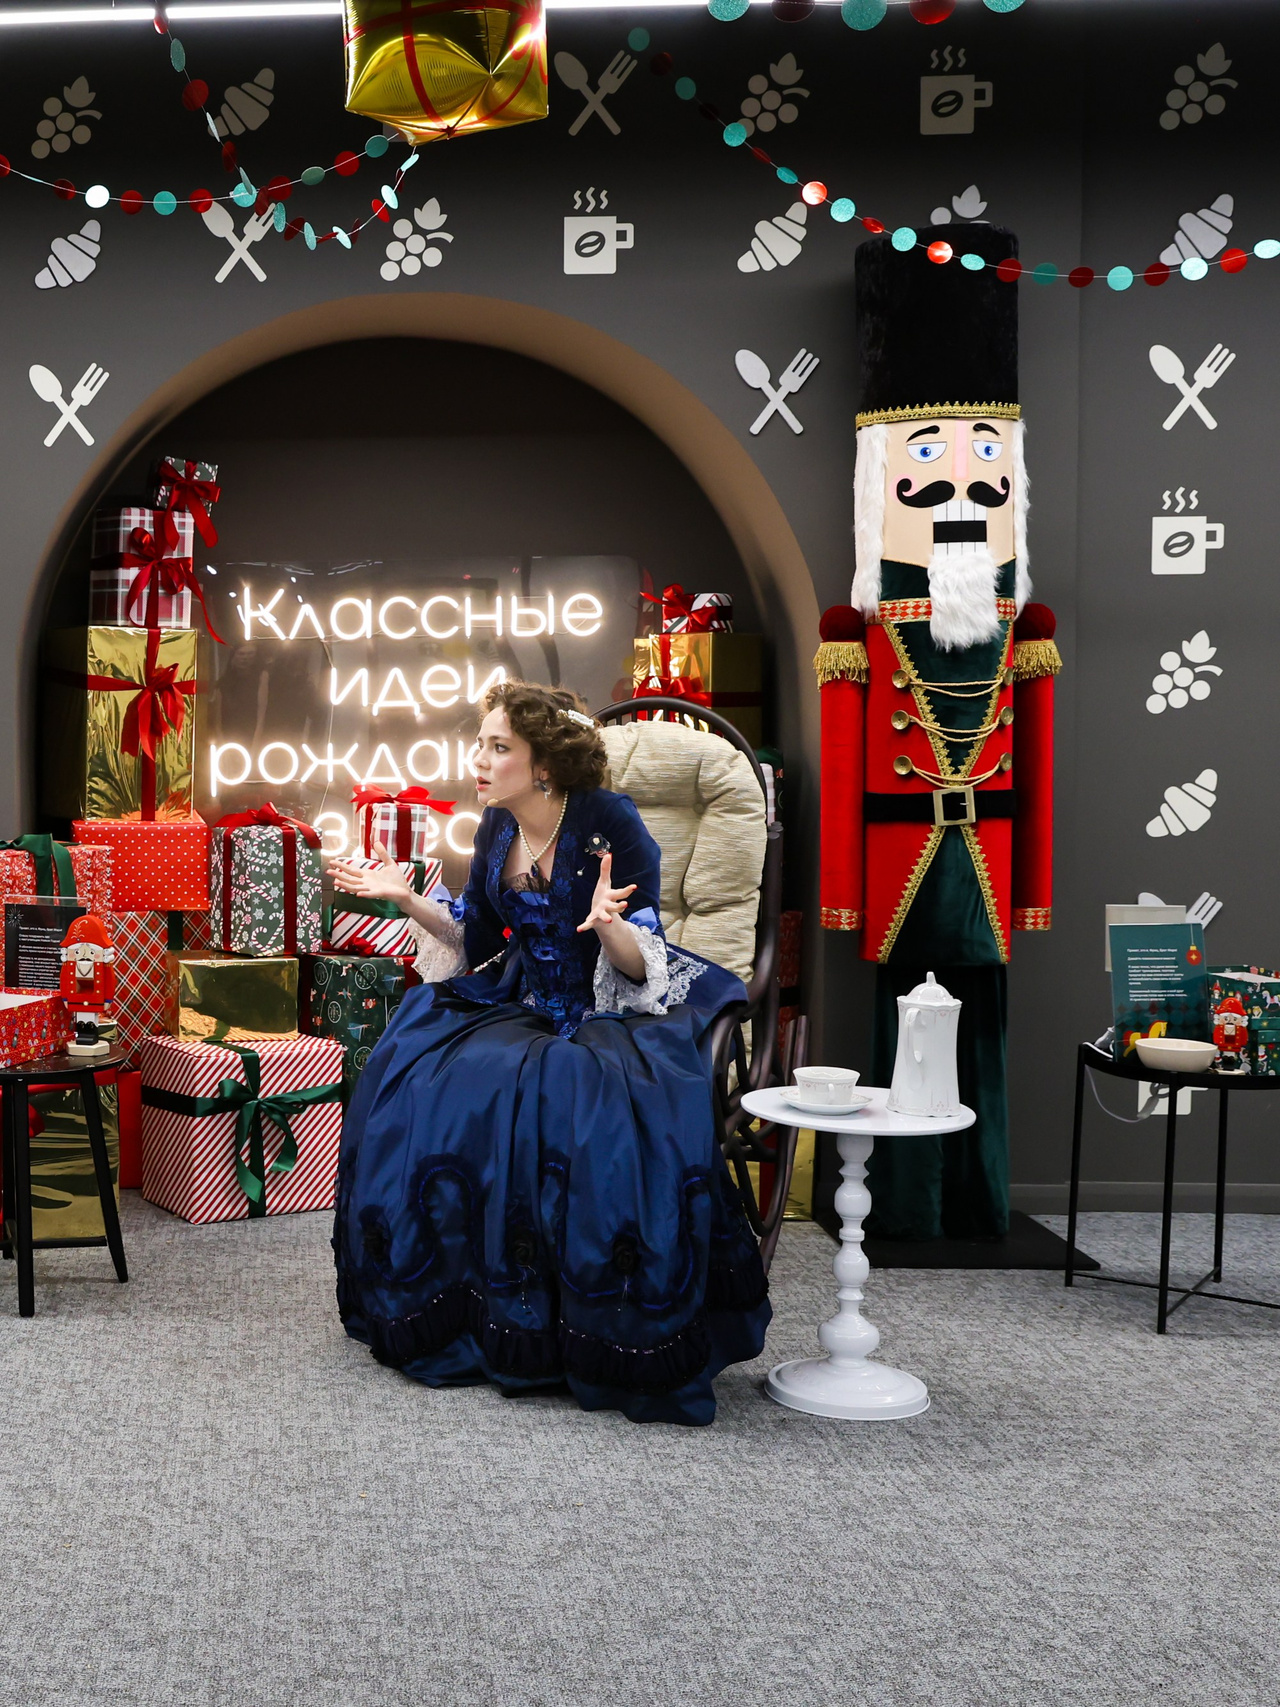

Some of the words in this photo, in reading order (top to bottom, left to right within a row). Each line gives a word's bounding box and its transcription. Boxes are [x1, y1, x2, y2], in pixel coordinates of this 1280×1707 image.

[242, 586, 603, 641] Классные
[330, 663, 507, 717] идеи
[210, 739, 479, 797] рожда
